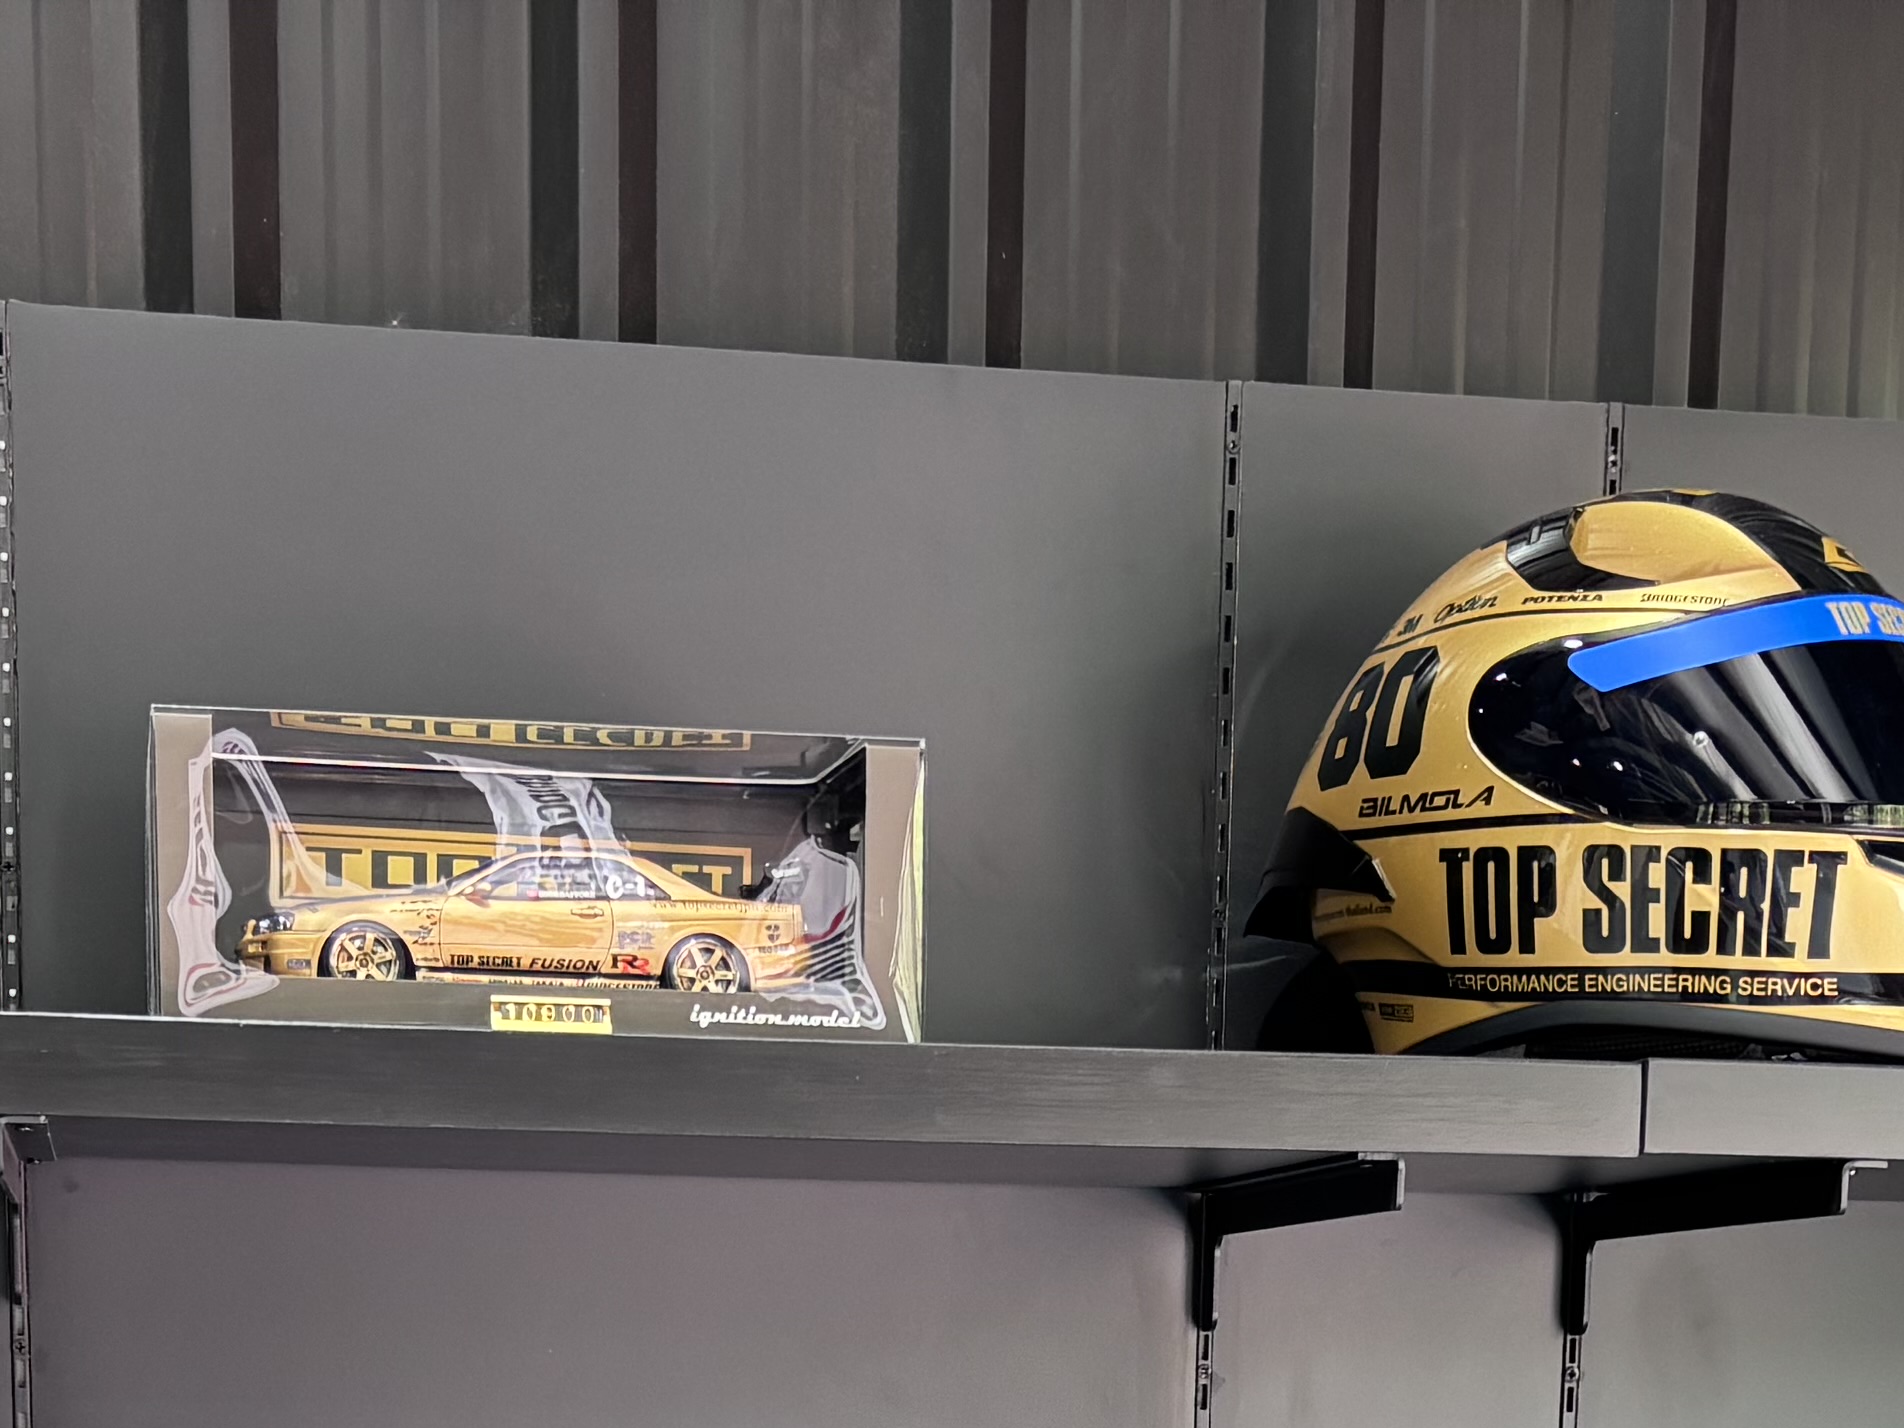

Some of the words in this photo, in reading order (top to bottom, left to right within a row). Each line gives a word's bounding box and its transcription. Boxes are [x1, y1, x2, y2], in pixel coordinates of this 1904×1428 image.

[1522, 593, 1603, 605] POTENZA
[1825, 602, 1871, 636] TOP
[1318, 646, 1440, 791] 80
[1358, 786, 1495, 819] BILMOLA
[1438, 845, 1557, 956] TOP
[1582, 843, 1848, 960] SECRET
[529, 957, 600, 972] FUSION
[1448, 973, 1579, 995] PERFORMANCE
[1583, 974, 1733, 997] ENGINEERING
[1737, 976, 1839, 997] SERVICE
